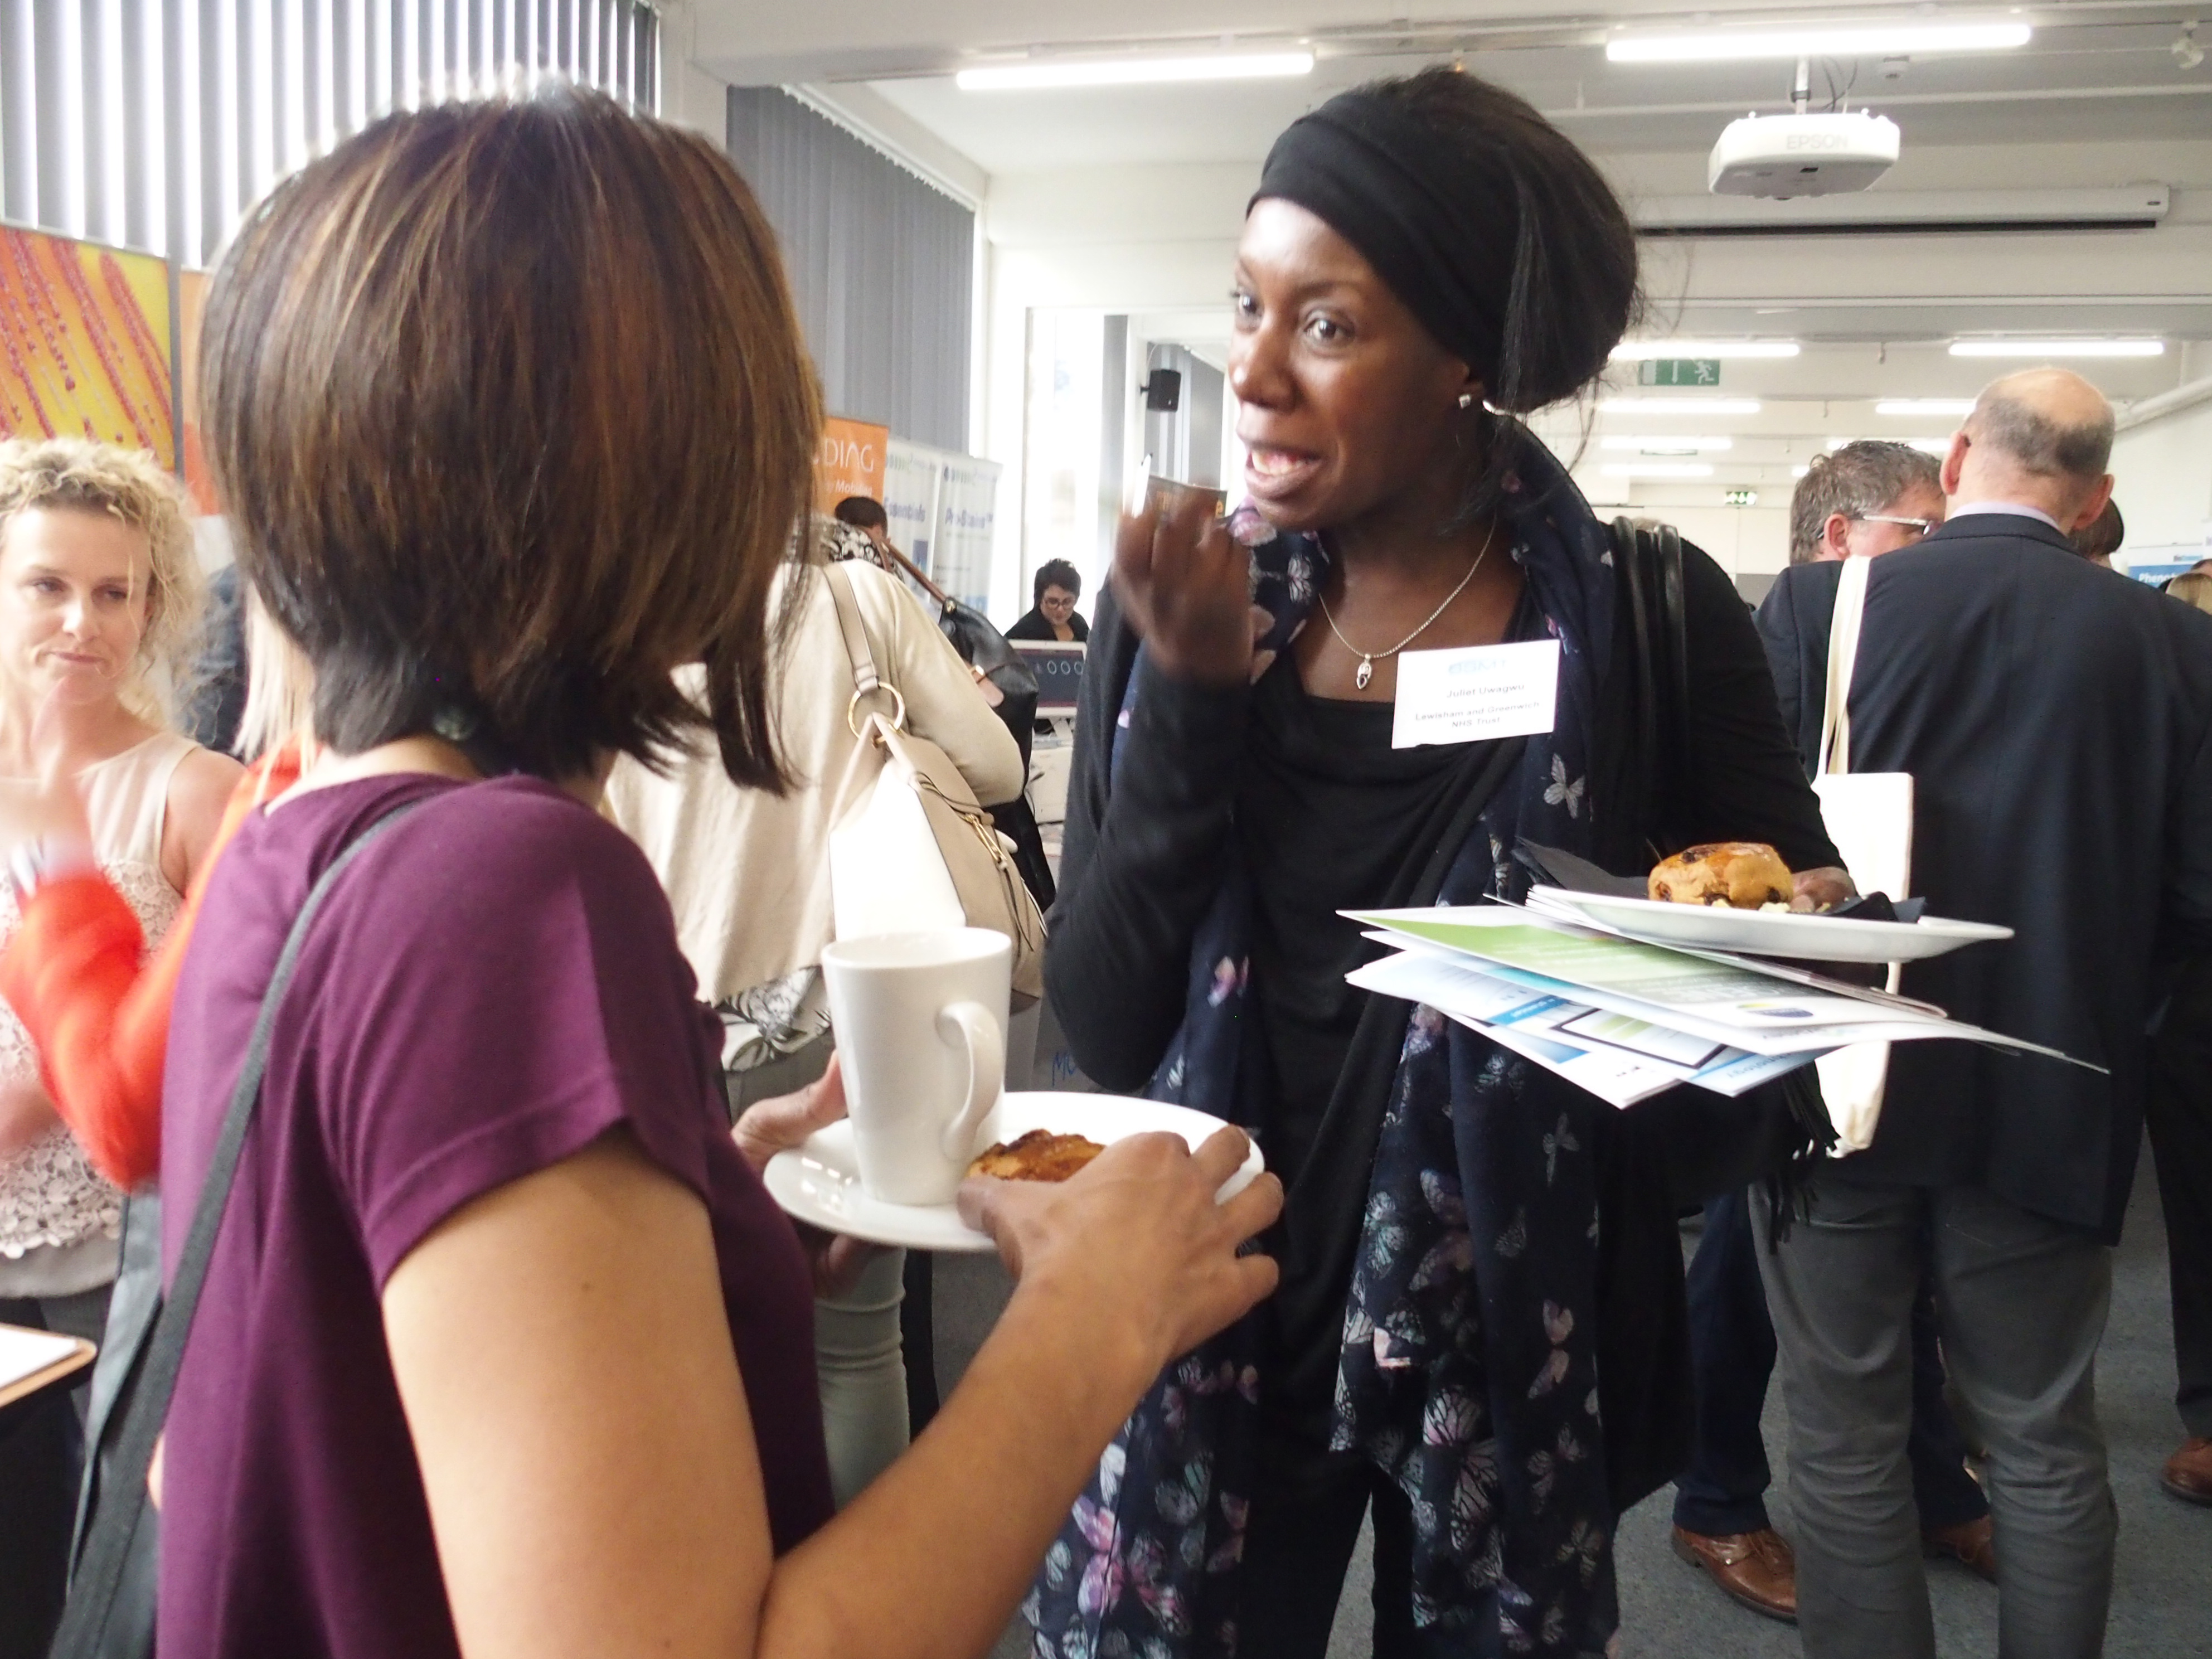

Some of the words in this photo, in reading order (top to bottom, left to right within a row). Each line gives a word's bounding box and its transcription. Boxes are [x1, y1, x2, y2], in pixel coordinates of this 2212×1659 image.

[1786, 134, 1848, 149] EPSON
[1446, 688, 1476, 698] Juliet
[1479, 683, 1525, 695] Uwagwu
[1415, 711, 1463, 721] Lewisham
[1467, 707, 1484, 716] and
[1488, 701, 1539, 714] Greenwich
[1452, 719, 1472, 728] NHS
[1477, 717, 1501, 725] Trust
